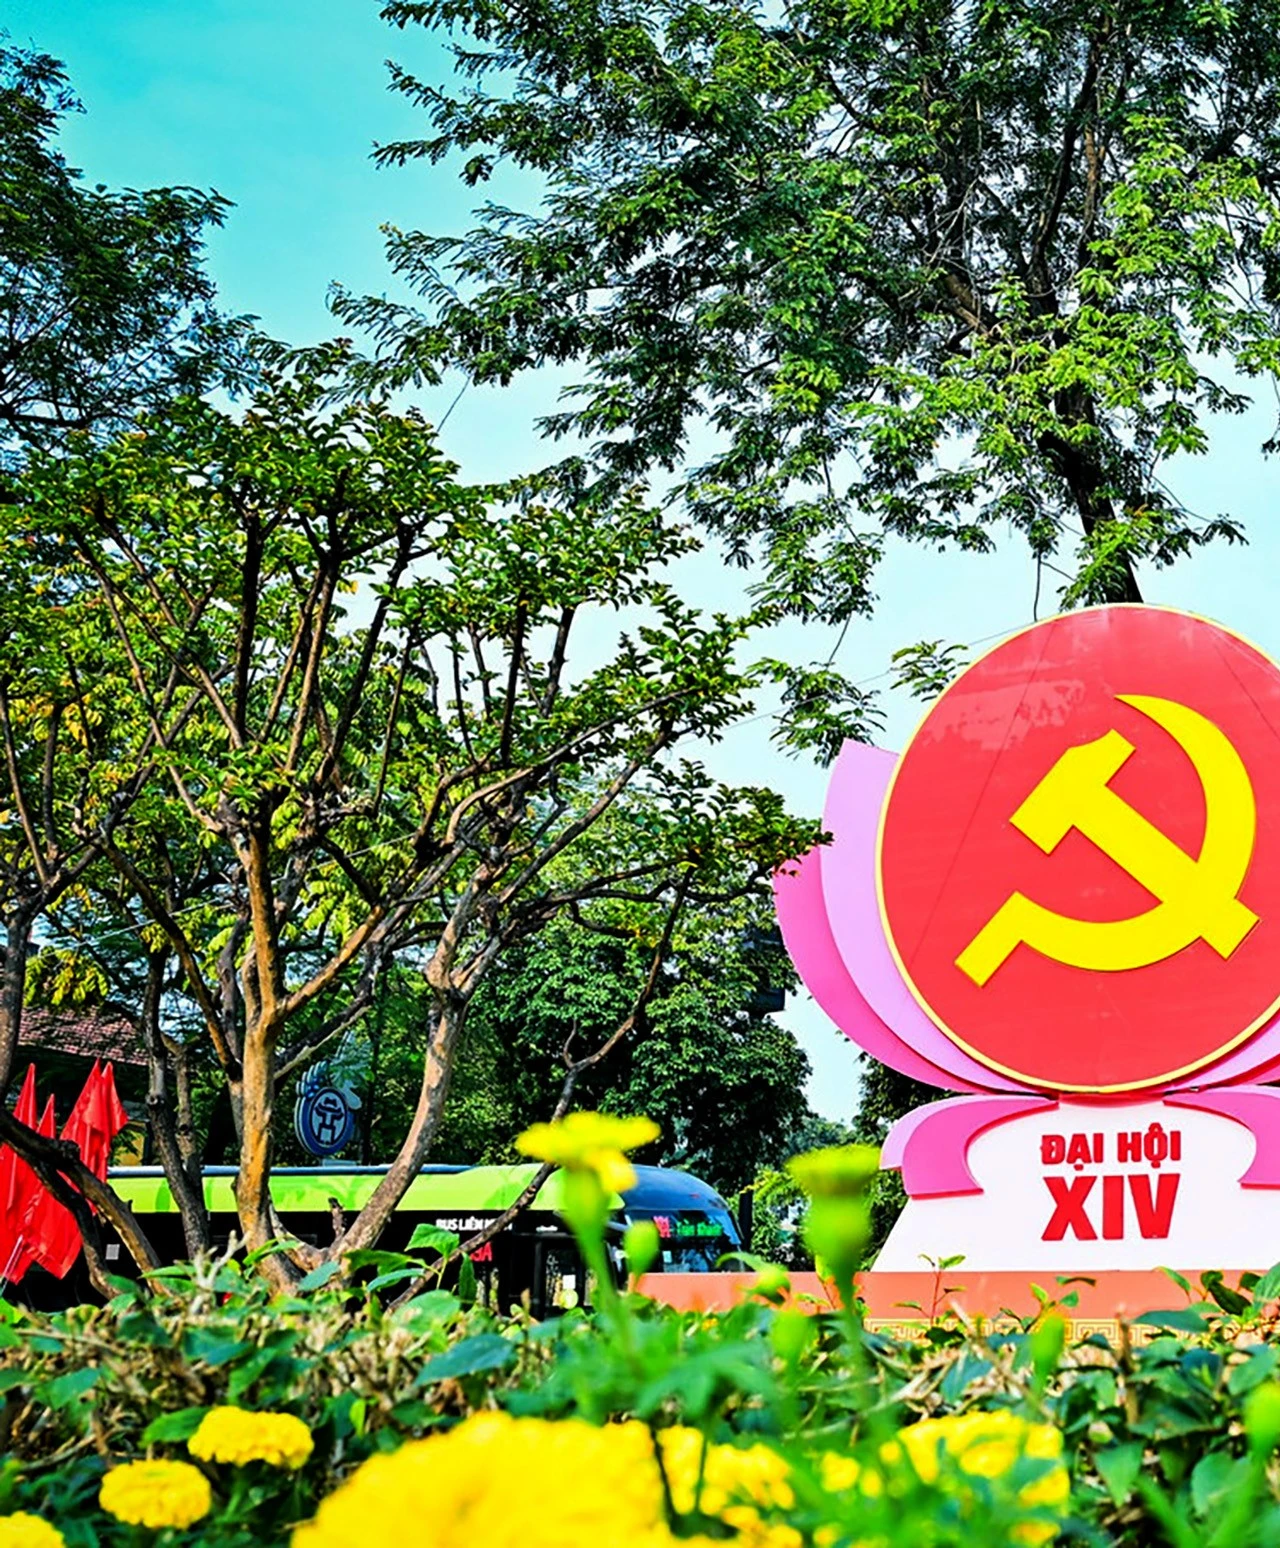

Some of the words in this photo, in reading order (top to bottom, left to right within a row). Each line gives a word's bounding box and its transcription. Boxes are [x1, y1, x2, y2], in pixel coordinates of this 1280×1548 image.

[1040, 1133, 1104, 1171] ĐẠI
[1117, 1122, 1181, 1169] HỘI
[1041, 1173, 1181, 1241] XIV
